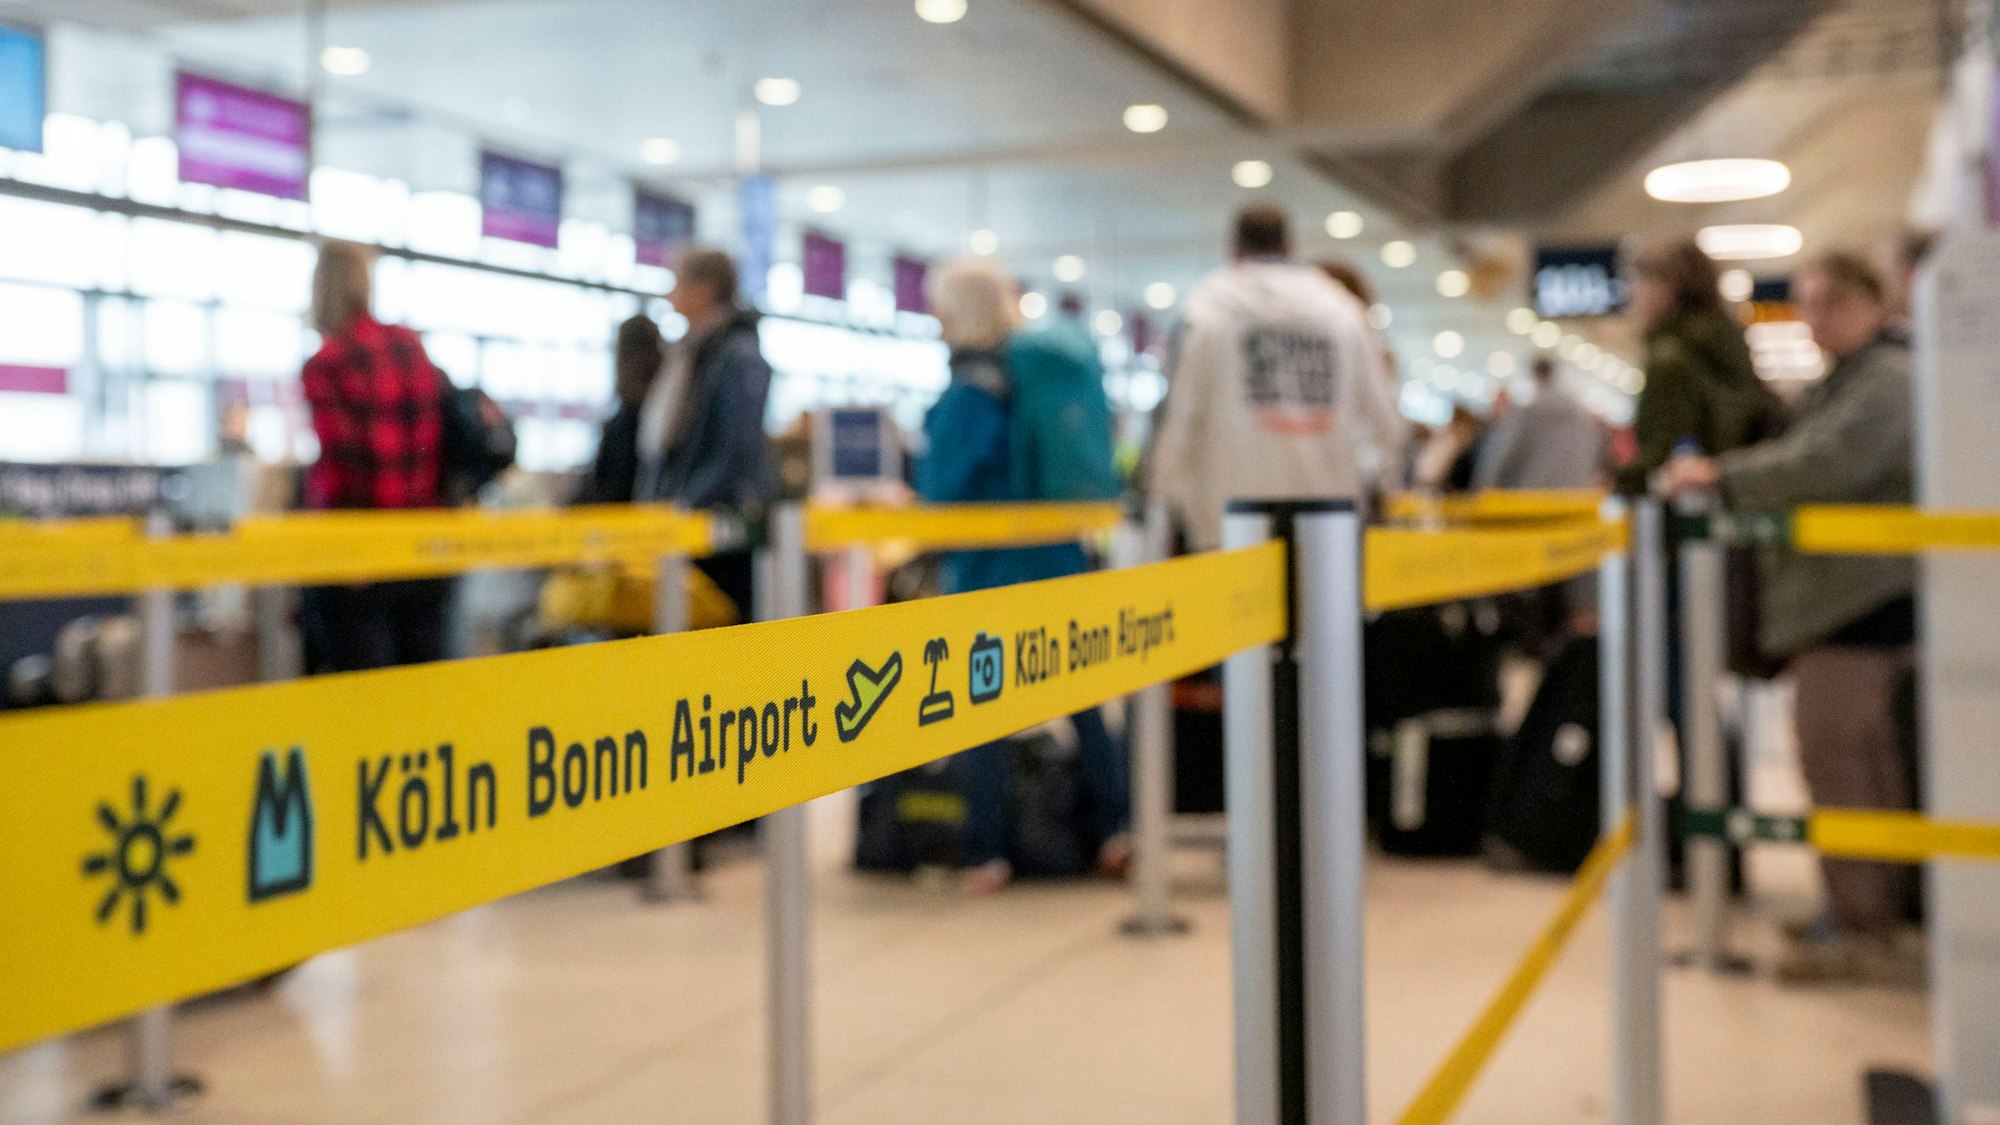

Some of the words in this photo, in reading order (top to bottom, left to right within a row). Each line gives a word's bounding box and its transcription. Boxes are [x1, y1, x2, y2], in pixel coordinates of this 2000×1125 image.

[1015, 626, 1060, 686] Köln
[1069, 619, 1110, 672] Bonn
[1118, 606, 1175, 661] Airport
[356, 743, 497, 863] Köln
[527, 726, 648, 819] Bonn
[670, 679, 817, 785] Airport
